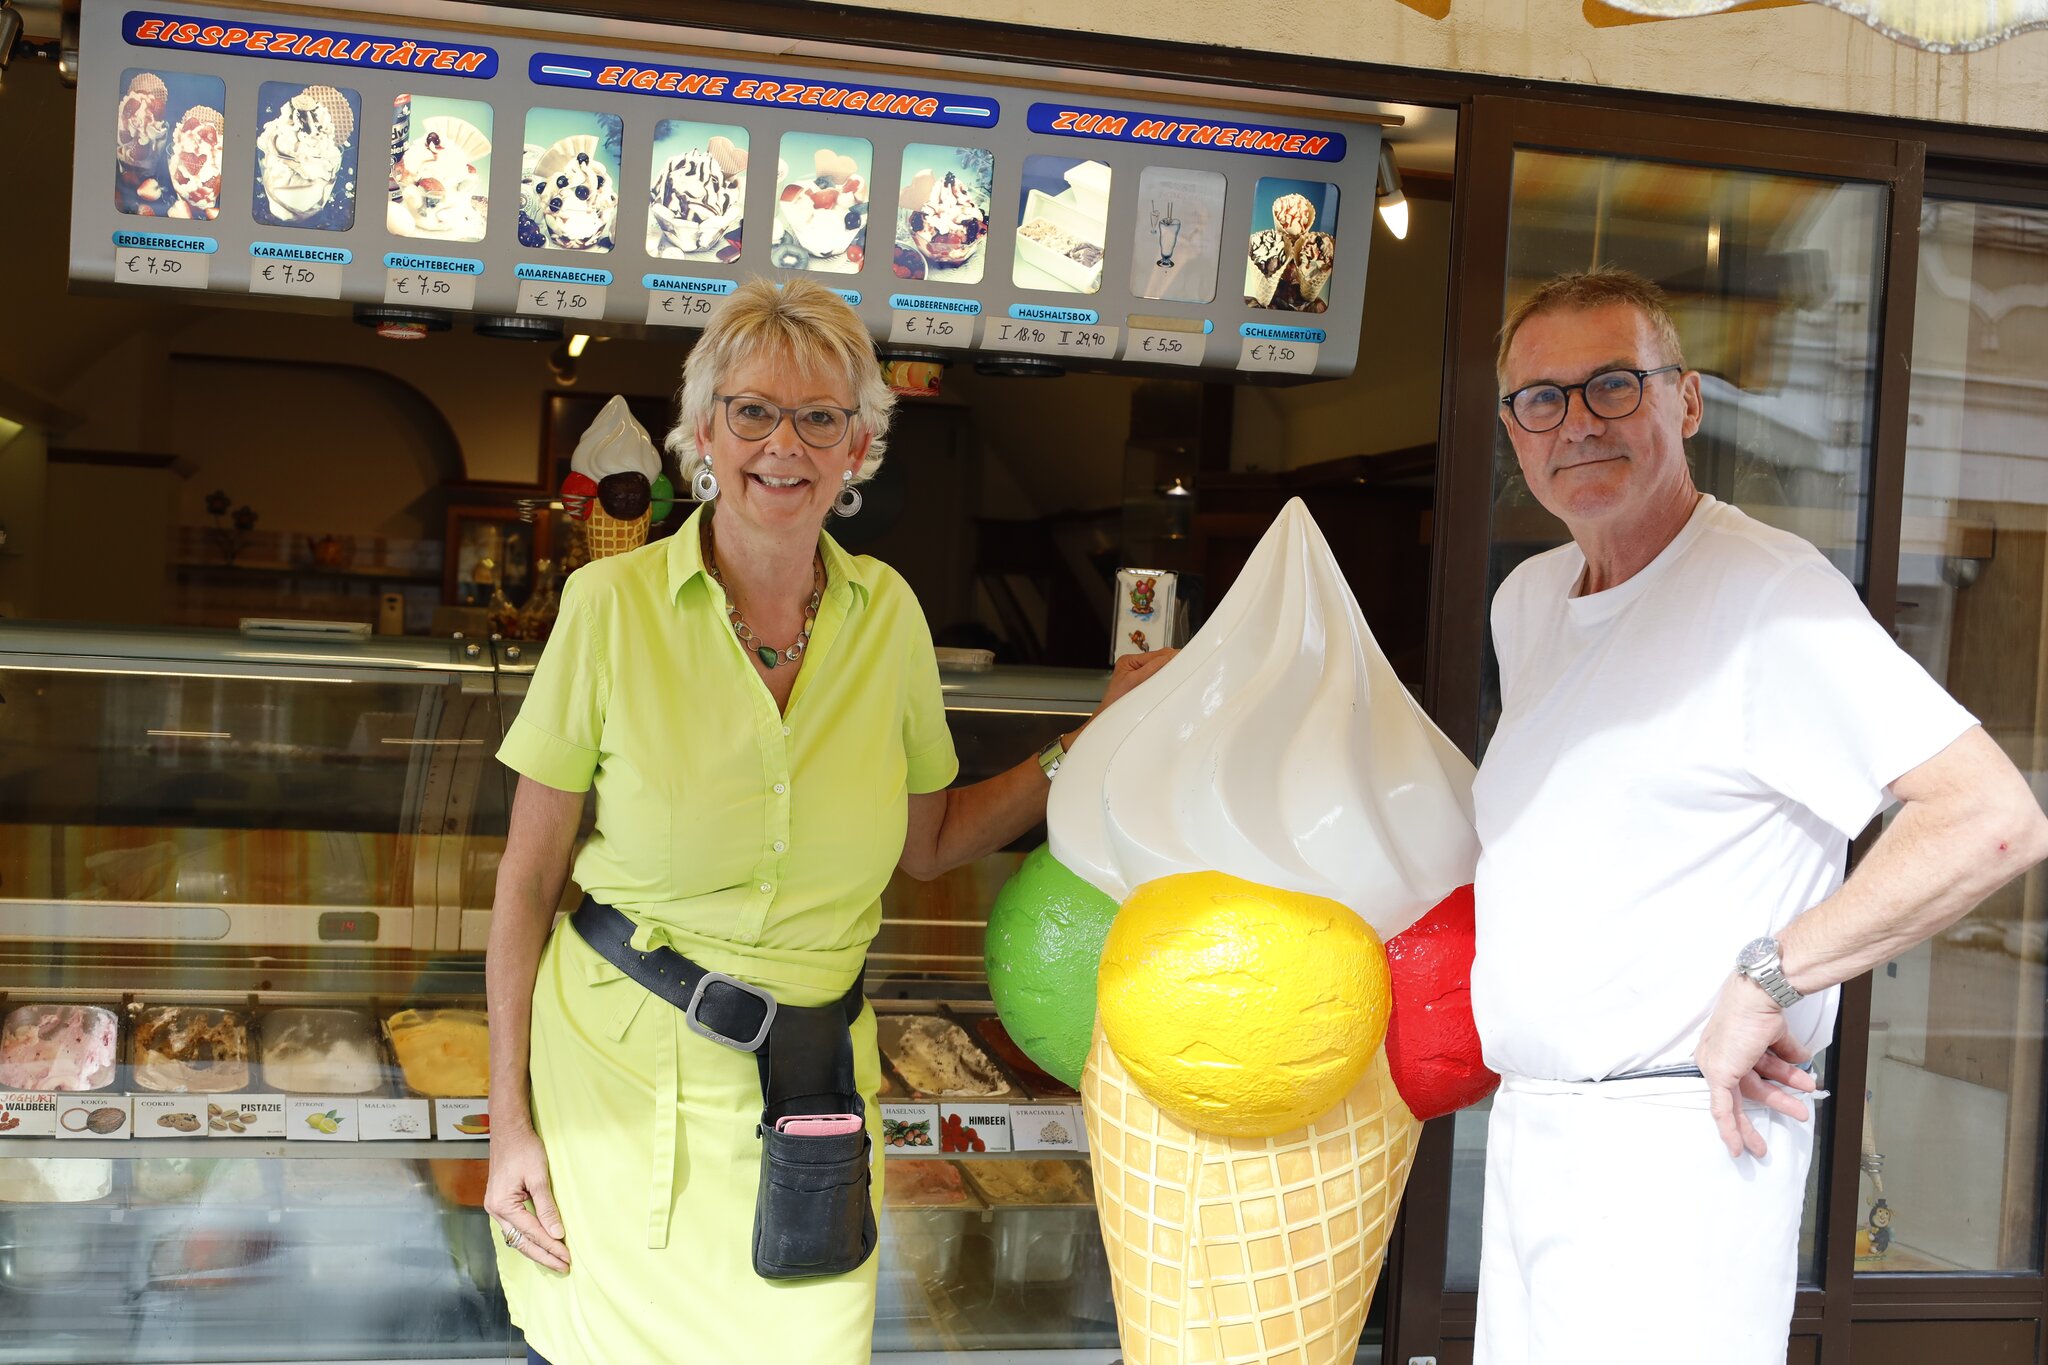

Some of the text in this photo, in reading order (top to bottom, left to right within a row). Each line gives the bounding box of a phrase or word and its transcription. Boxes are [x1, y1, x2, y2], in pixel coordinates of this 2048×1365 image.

[136, 19, 487, 73] EISSPEZIALITÄTEN
[597, 66, 939, 118] EIGENE ERZEUGUNG
[1052, 111, 1330, 156] ZUM MITNEHMEN
[118, 235, 205, 250] ERDBEERBECHER
[254, 246, 345, 262] KARAMELBECHER
[125, 256, 182, 274] € 7,50
[390, 256, 475, 272] FRÜCHTEBECHER
[262, 265, 315, 284] € 7,50
[517, 268, 606, 283] AMARENABECHER
[397, 275, 450, 295] € 7,50
[652, 279, 727, 293] BANANENSPLIT
[534, 290, 587, 309] € 7,50
[662, 295, 711, 315] € 7,50
[896, 298, 979, 313] WALDBEERENBECHER
[1018, 309, 1092, 322] HAUSHALTSBOX
[906, 317, 953, 335] € 7,50
[1245, 327, 1322, 341] SCHLEMMERTÜTE
[1014, 326, 1046, 343] 18,90
[1075, 331, 1105, 348] 29,90
[1143, 336, 1182, 352] € 5,50
[1250, 345, 1295, 362] € 7,50
[5, 1102, 56, 1111] WALDBEER
[240, 1103, 282, 1112] PISTAZIE
[968, 1116, 1006, 1126] HIMBEER
